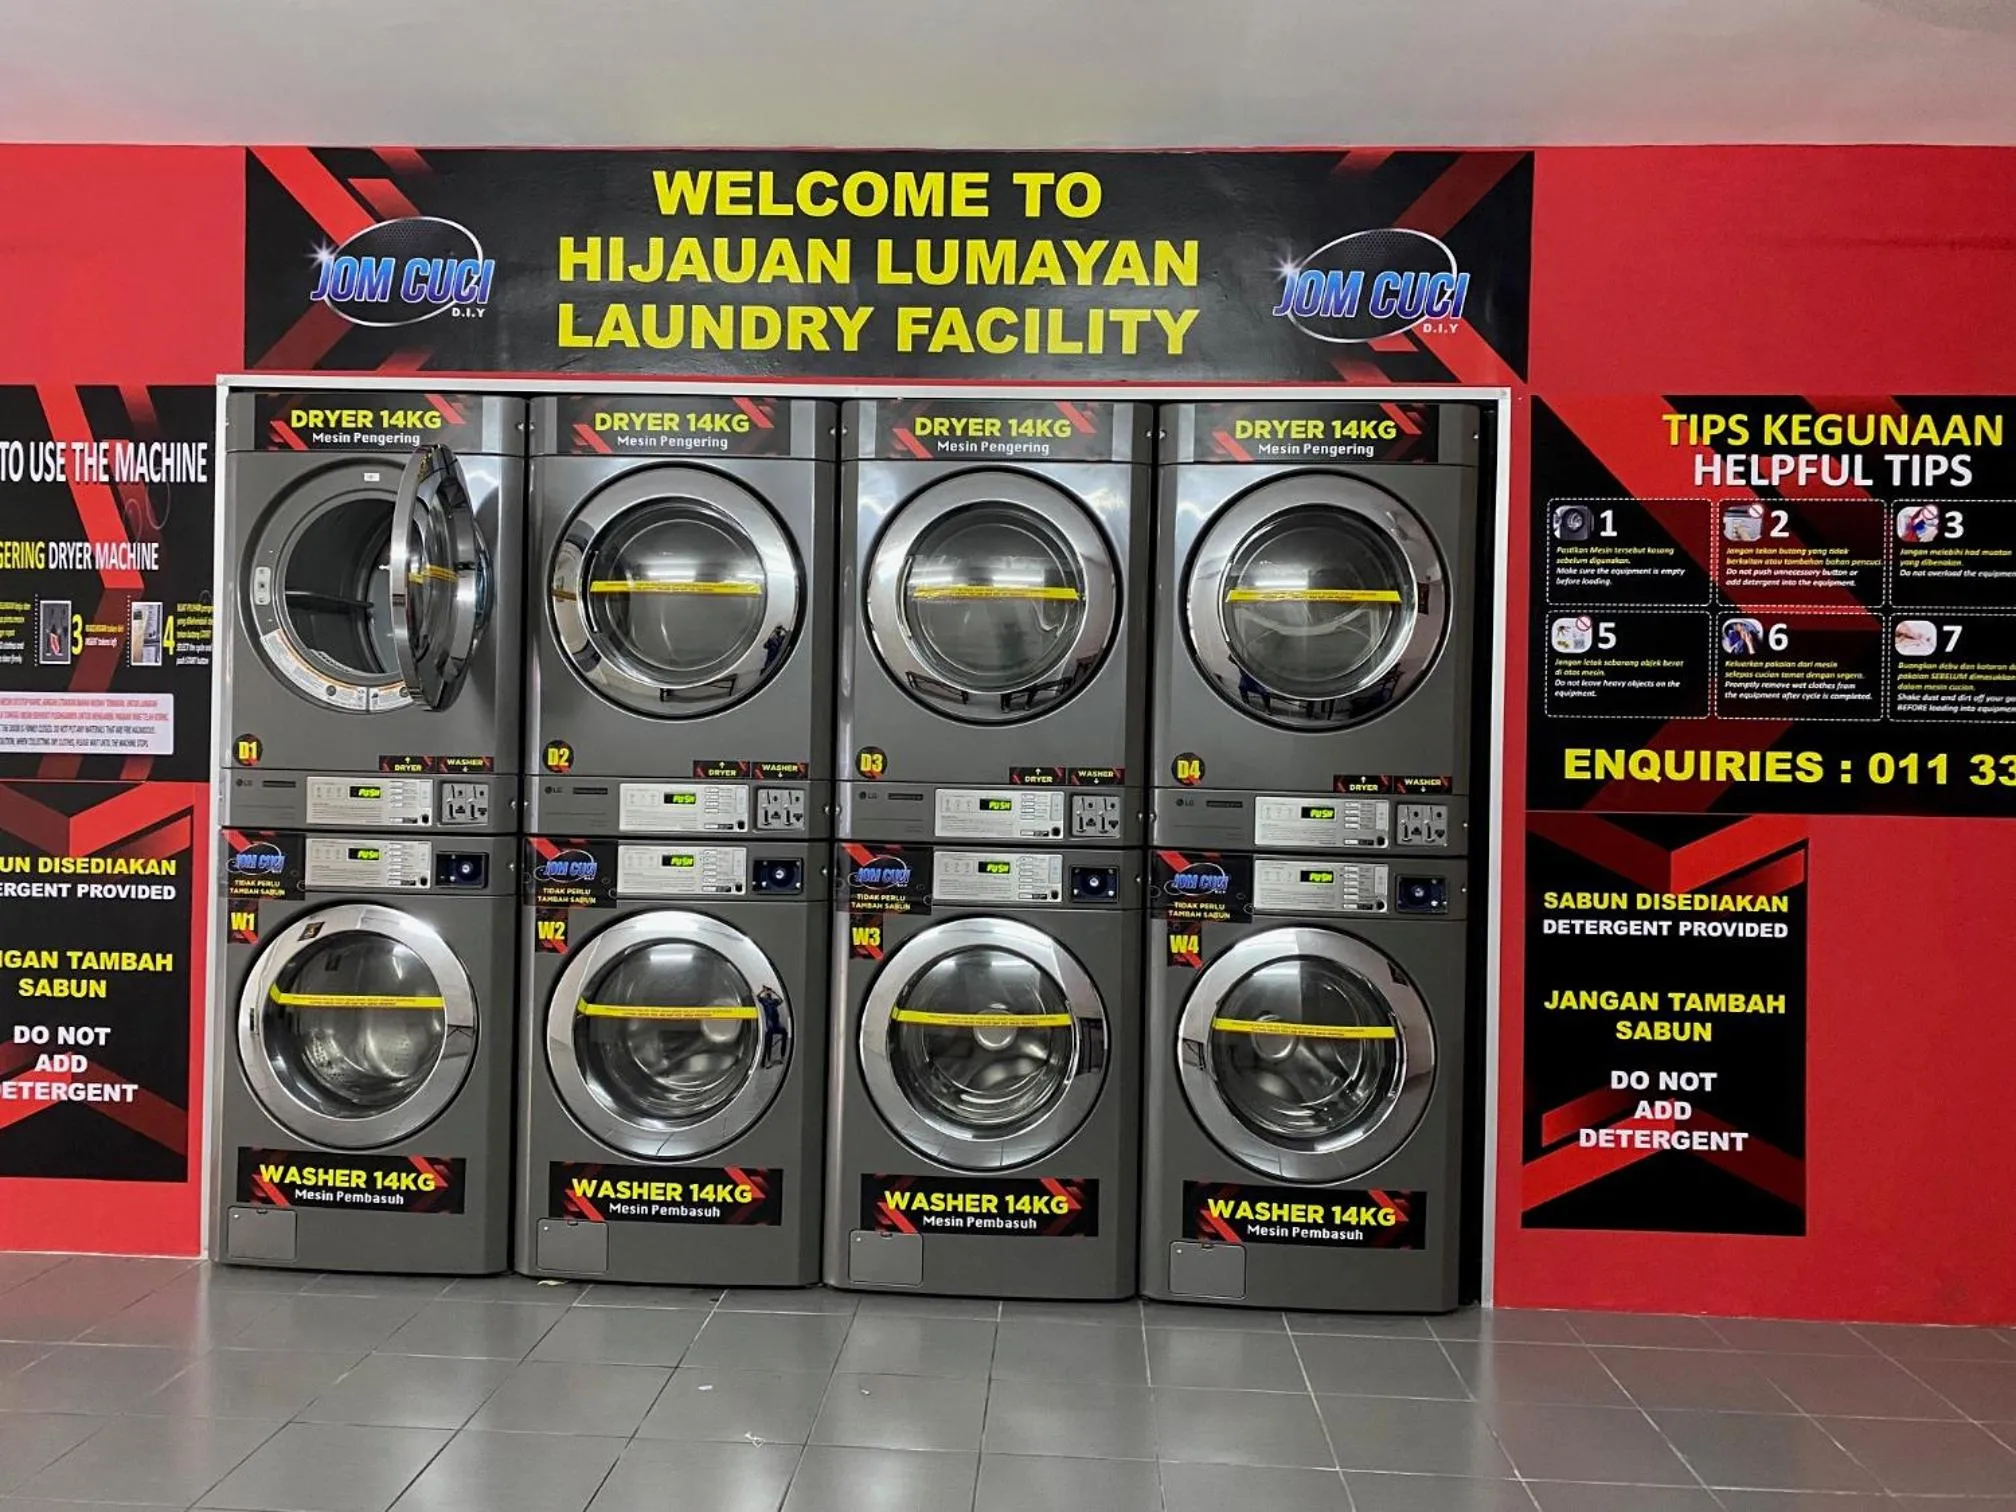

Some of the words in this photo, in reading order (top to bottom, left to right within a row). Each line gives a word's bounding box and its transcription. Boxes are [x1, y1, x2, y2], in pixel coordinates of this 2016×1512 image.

[652, 170, 989, 217] WELCOME
[1013, 172, 1103, 218] TO
[559, 236, 853, 284] HIJAUAN
[877, 240, 1199, 286] LUMAYAN
[310, 256, 398, 303] JOM
[401, 258, 496, 304] CUCI
[1273, 269, 1361, 317] JOM
[1369, 271, 1470, 319] CUCI
[451, 308, 486, 319] D.I.Y
[557, 303, 875, 351] LAUNDRY
[897, 307, 1199, 355] FACILITY
[1422, 323, 1459, 333] D.I.Y
[290, 409, 373, 429] DRYER
[381, 410, 442, 430] 14KG
[594, 412, 680, 432] DRYER
[687, 413, 750, 433] 14KG
[914, 417, 1001, 436] DRYER
[1008, 418, 1071, 438] 14KG
[312, 432, 350, 443] Mesin
[353, 433, 420, 446] Pengering
[1235, 420, 1324, 439] DRYER
[1331, 421, 1397, 440] 14KG
[1662, 413, 1750, 447] TIPS
[1763, 413, 2003, 447] KEGUNAAN
[617, 436, 656, 447] Mesin
[660, 436, 728, 450] Pengering
[937, 441, 977, 452] Mesin
[981, 441, 1049, 455] Pengering
[1258, 443, 1299, 454] Mesin
[1303, 443, 1374, 457] Pengering
[0, 440, 24, 482] TO
[30, 441, 66, 482] USE
[71, 442, 109, 482] THE
[115, 442, 208, 483] MACHINE
[1695, 453, 1874, 486] HELPFUL
[1884, 454, 1973, 488] TIPS
[1600, 509, 1618, 537] 1
[1770, 510, 1790, 538] 2
[1944, 510, 1964, 539] 3
[48, 541, 92, 570] DRYER
[95, 543, 159, 571] MACHINE
[1597, 567, 1609, 575] the
[71, 614, 83, 655] 3
[163, 615, 175, 655] 4
[1597, 622, 1617, 650] 5
[1768, 623, 1789, 651] 6
[1942, 625, 1963, 653] 7
[238, 742, 257, 760] D1
[547, 748, 569, 766] D2
[394, 764, 422, 772] DRYER
[762, 764, 797, 772] WASHER
[860, 753, 883, 772] D3
[1177, 760, 1200, 779] D4
[1564, 748, 1824, 783] ENQUIRIES
[1840, 760, 1852, 783] :
[1868, 752, 1947, 786] 011
[1969, 753, 2016, 787] 33
[1078, 770, 1114, 778] WASHER
[1404, 778, 1441, 786] WASHER
[359, 787, 380, 797] PUSH
[673, 794, 695, 803] PUSH
[989, 801, 1012, 810] PUSH
[1310, 809, 1334, 818] PUSH
[358, 850, 379, 860] PUSH
[671, 857, 694, 866] PUSH
[0, 856, 30, 873] UN
[38, 857, 176, 876] DISEDIAKAN
[987, 863, 1010, 873] PUSH
[1309, 873, 1333, 882] PUSH
[0, 882, 71, 898] RGENT
[77, 883, 176, 900] PROVIDED
[1544, 892, 1627, 909] SABUN
[1636, 893, 1788, 912] DISEDIAKAN
[231, 912, 255, 931] W1
[537, 921, 565, 940] W2
[1543, 920, 1672, 936] DETERGENT
[1679, 921, 1788, 938] PROVIDED
[852, 927, 881, 946] W3
[1169, 935, 1199, 954] W4
[0, 950, 58, 969] GAN
[67, 951, 173, 971] TAMBAH
[18, 979, 107, 998] SABUN
[1544, 990, 1658, 1011] JANGAN
[1668, 992, 1786, 1013] TAMBAH
[14, 1026, 49, 1044] DO
[57, 1026, 111, 1046] NOT
[1616, 1021, 1712, 1041] SABUN
[34, 1055, 88, 1073] ADD
[0, 1081, 138, 1102] ETERGENT
[1611, 1071, 1650, 1090] DO
[1659, 1071, 1717, 1092] NOT
[1634, 1100, 1692, 1121] ADD
[1579, 1128, 1748, 1151] DETERGENT
[259, 1164, 367, 1189] WASHER
[374, 1171, 436, 1192] 14KG
[295, 1189, 334, 1201] Mesin
[337, 1191, 404, 1205] Pembasuh
[571, 1178, 683, 1201] WASHER
[689, 1184, 753, 1203] 14KG
[609, 1203, 648, 1215] Mesin
[652, 1204, 721, 1217] Pembasuh
[884, 1191, 998, 1213] WASHER
[1005, 1195, 1069, 1215] 14KG
[1207, 1198, 1324, 1224] WASHER
[1331, 1206, 1396, 1227] 14KG
[923, 1215, 963, 1227] Mesin
[967, 1216, 1037, 1229] Pembasuh
[1247, 1225, 1288, 1237] Mesin
[1292, 1226, 1363, 1241] Pembasuh
